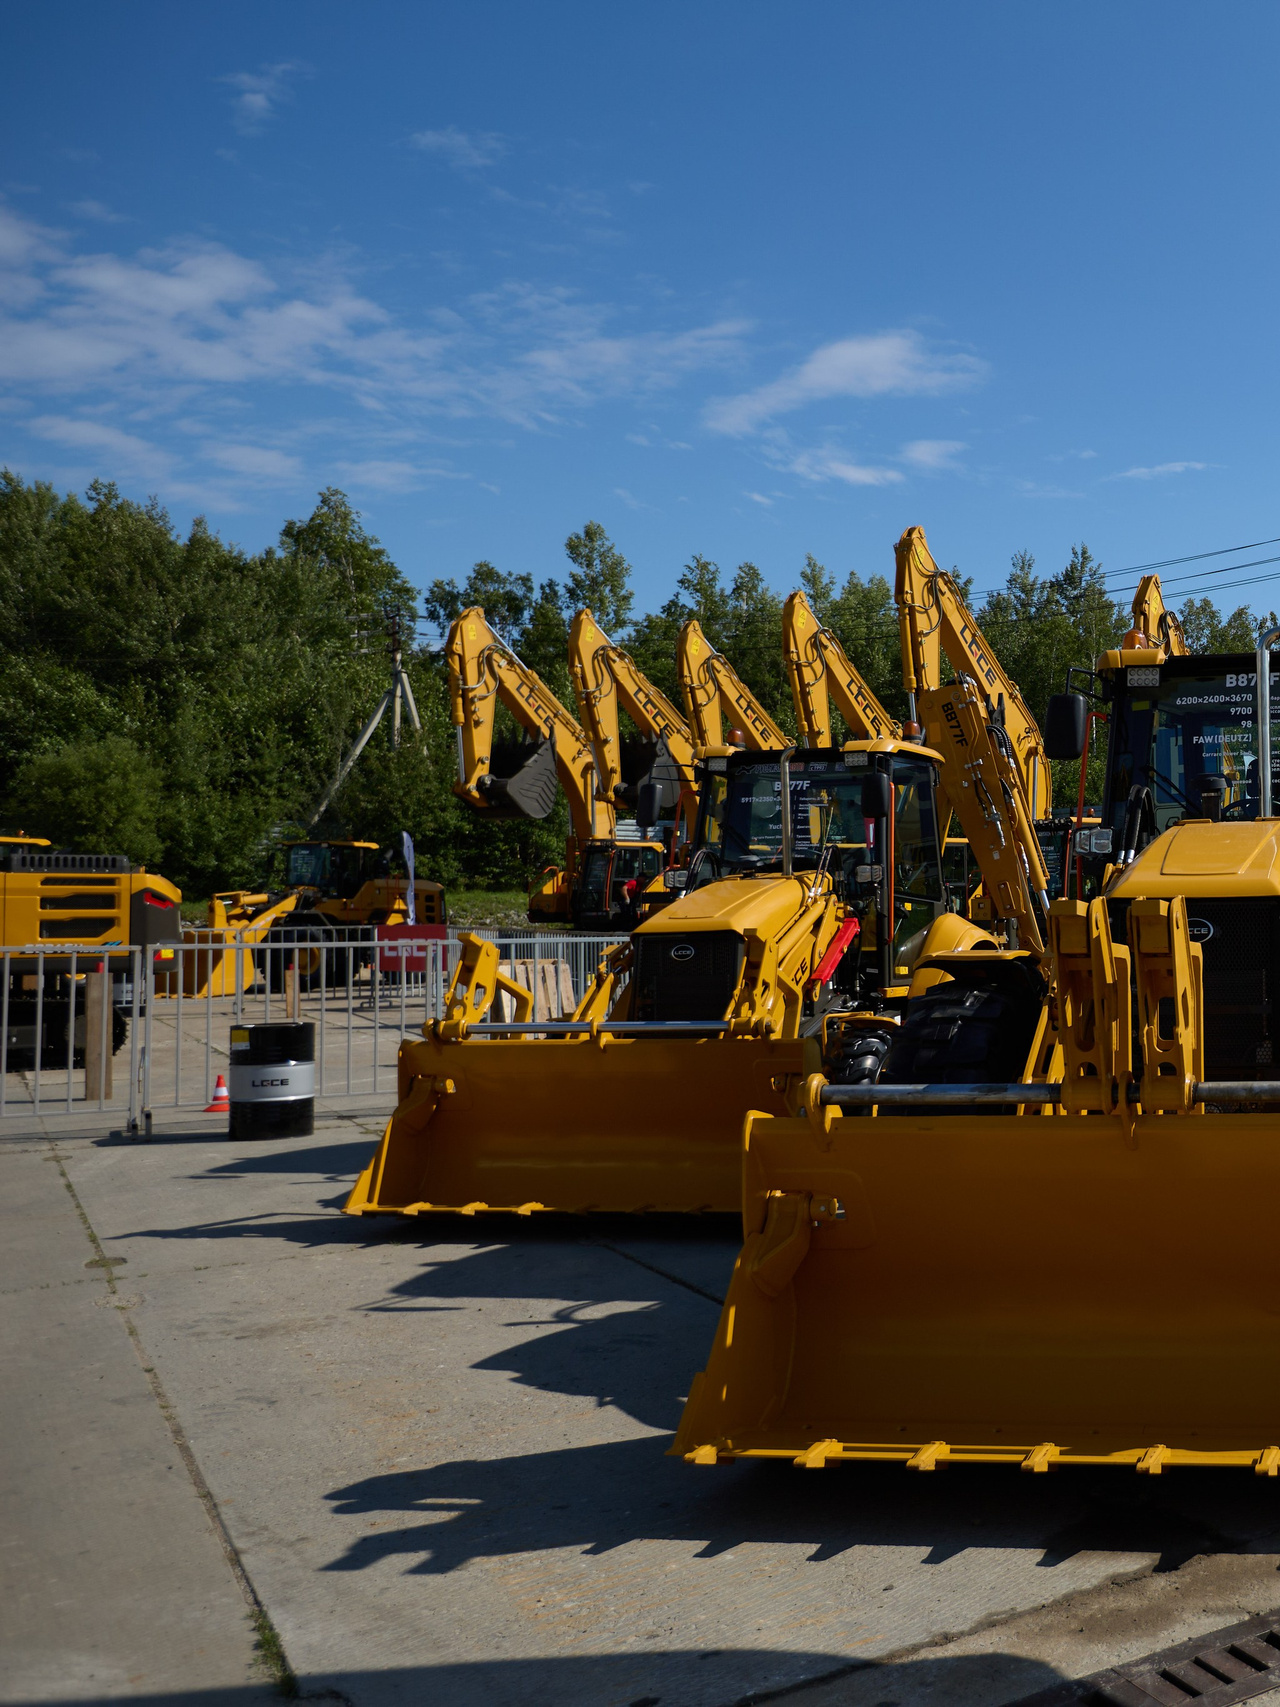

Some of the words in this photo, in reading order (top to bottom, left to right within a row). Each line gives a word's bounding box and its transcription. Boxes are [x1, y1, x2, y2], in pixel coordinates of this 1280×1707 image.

[1226, 672, 1280, 688] B87F
[1229, 706, 1253, 716] 9700
[941, 701, 968, 748] BB77F
[1240, 720, 1253, 729] 98
[774, 780, 811, 791] B77F
[1188, 927, 1209, 935] CE
[791, 957, 808, 986] CE
